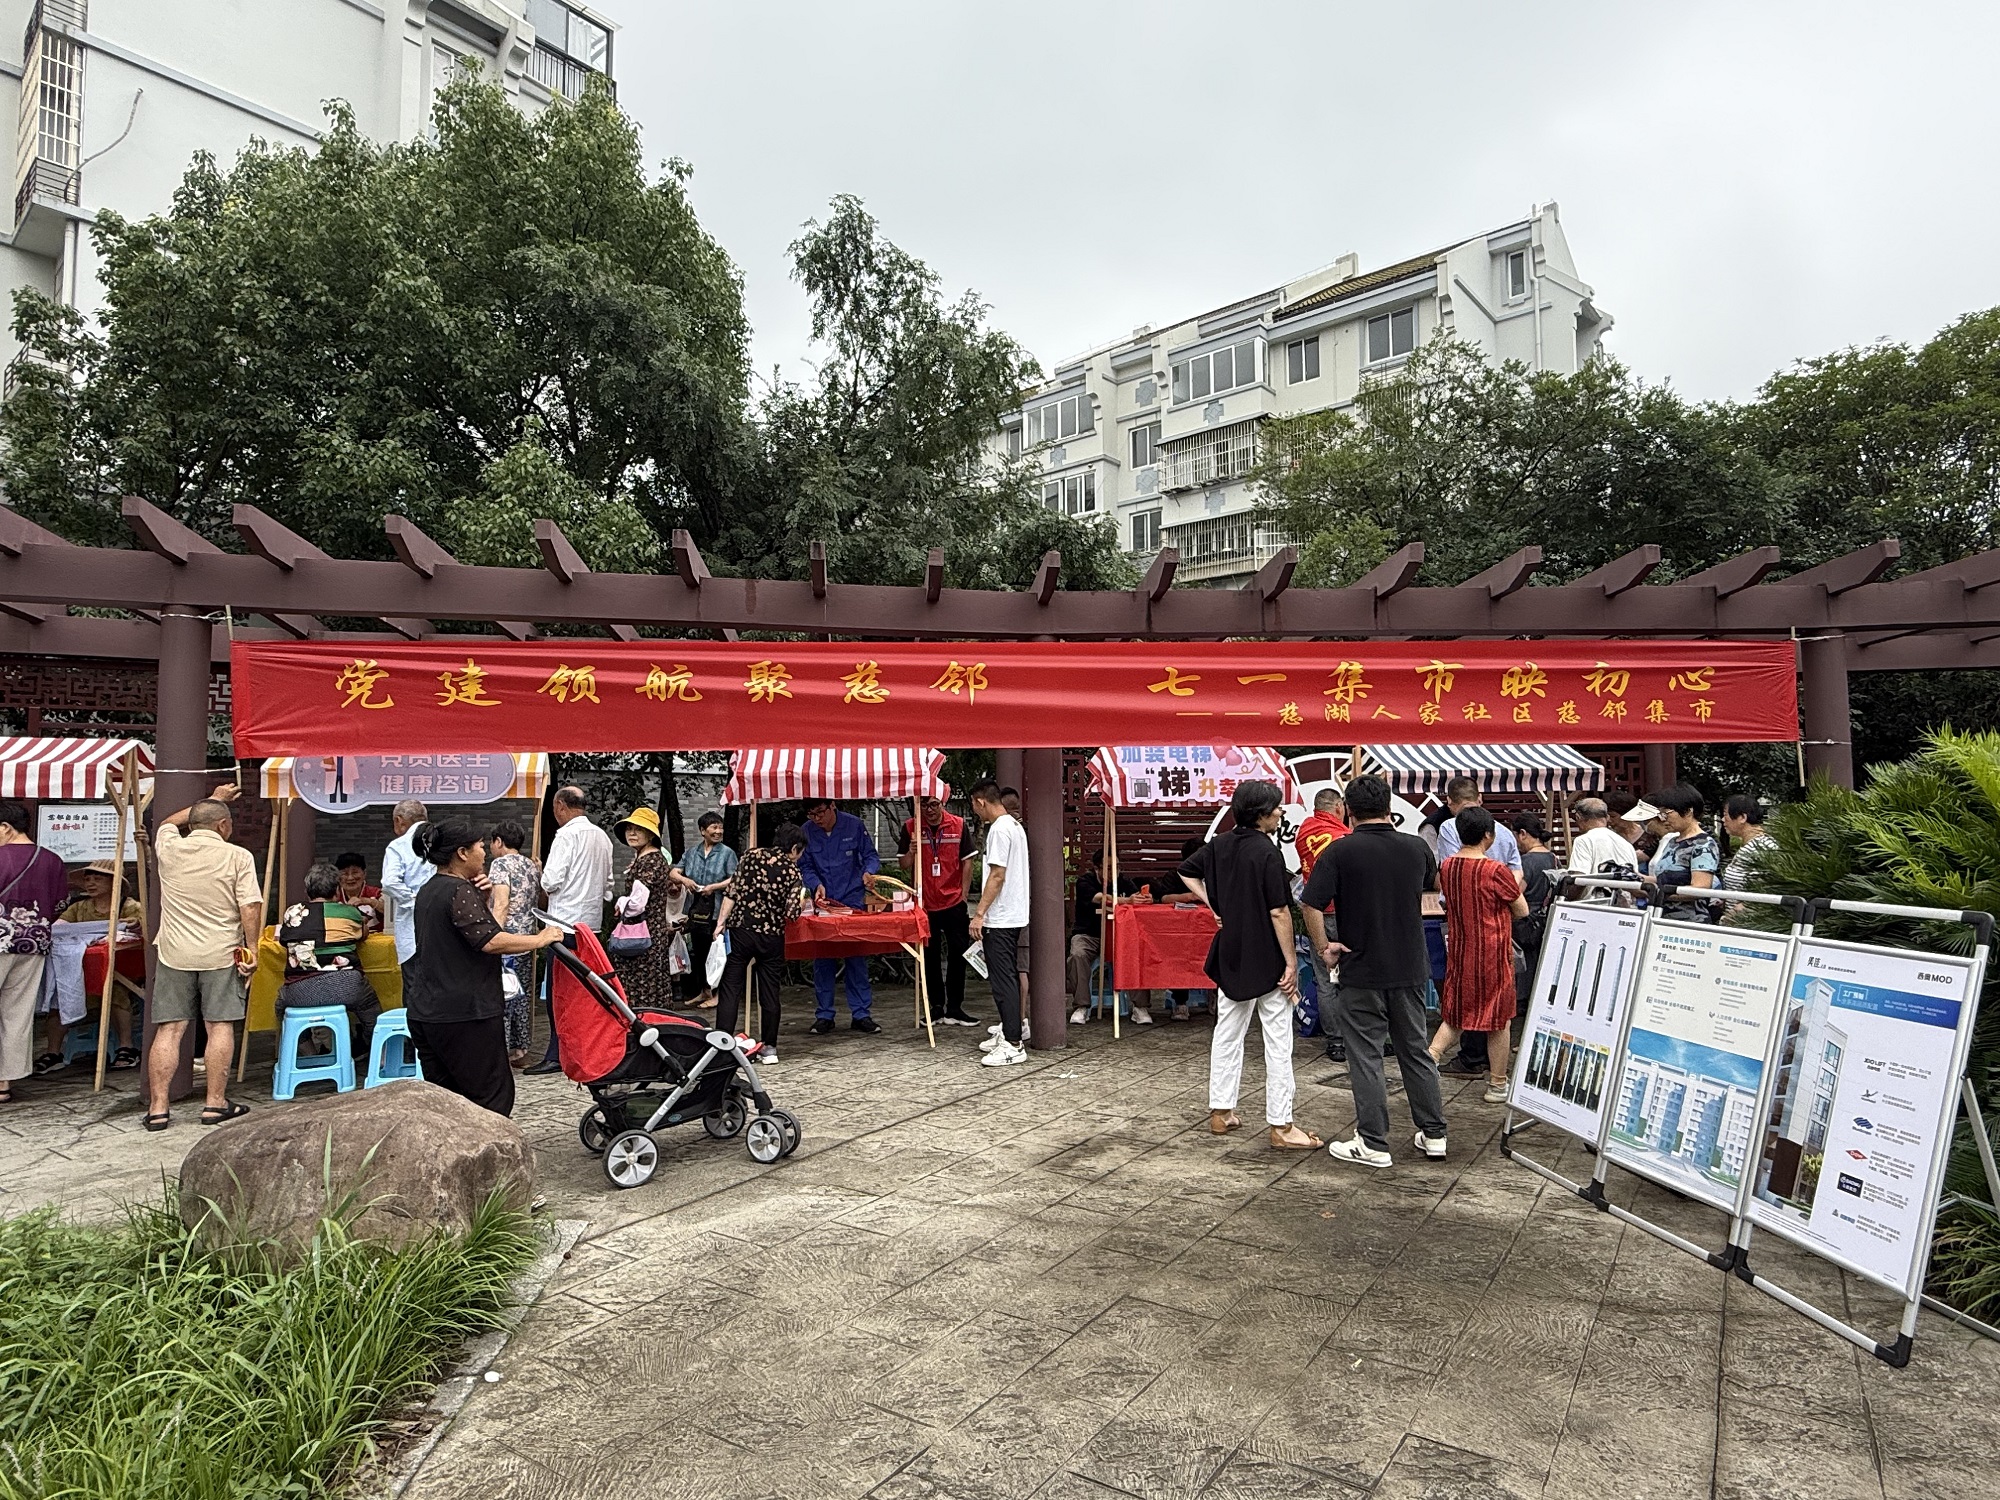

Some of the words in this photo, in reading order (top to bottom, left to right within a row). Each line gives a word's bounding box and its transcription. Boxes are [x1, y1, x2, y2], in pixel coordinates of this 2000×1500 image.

[335, 659, 991, 709] 党建领航聚慈邻
[1146, 658, 1716, 703] 七一集市映初心
[1121, 746, 1212, 763] 加装电梯
[379, 774, 490, 794] 健康咨询
